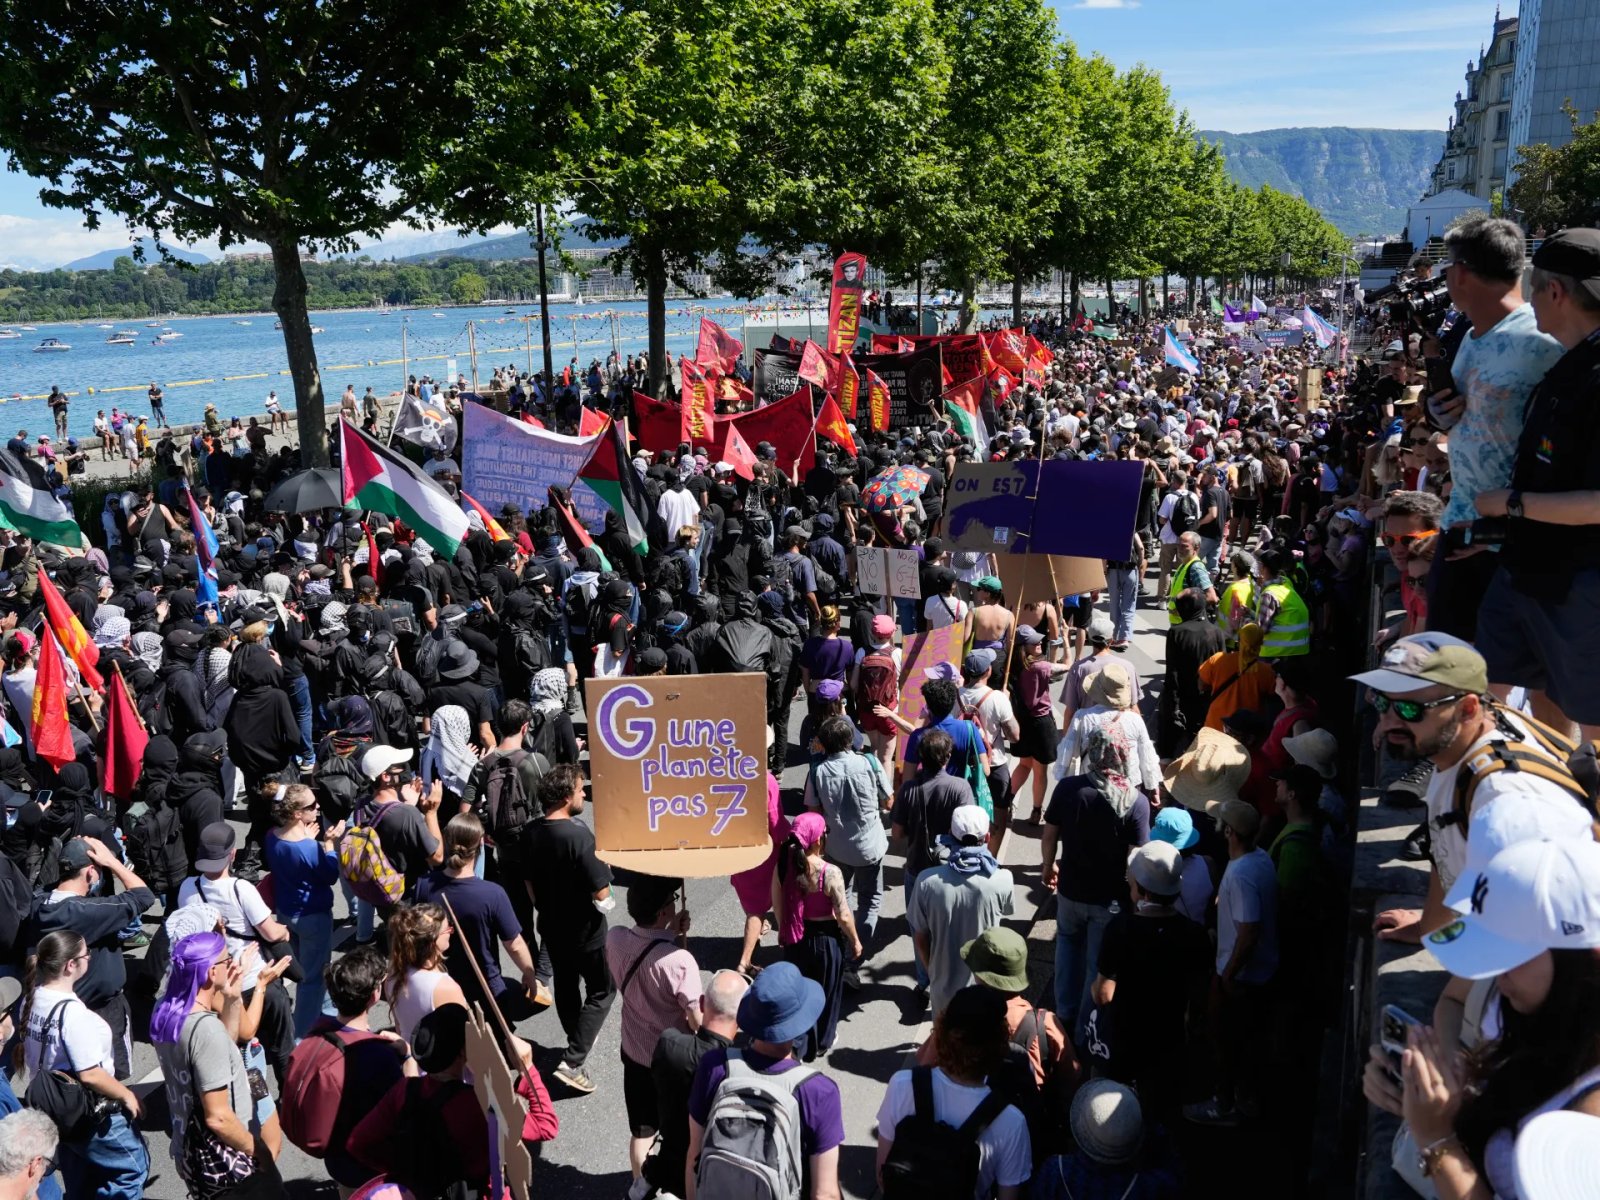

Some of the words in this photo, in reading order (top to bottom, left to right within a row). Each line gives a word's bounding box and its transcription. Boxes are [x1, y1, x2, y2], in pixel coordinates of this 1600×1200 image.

[954, 478, 979, 492] ON
[992, 477, 1025, 495] EST
[596, 684, 656, 760] G
[668, 718, 735, 748] une
[641, 744, 759, 794] planète
[648, 793, 707, 831] pas
[710, 784, 747, 835] 7
